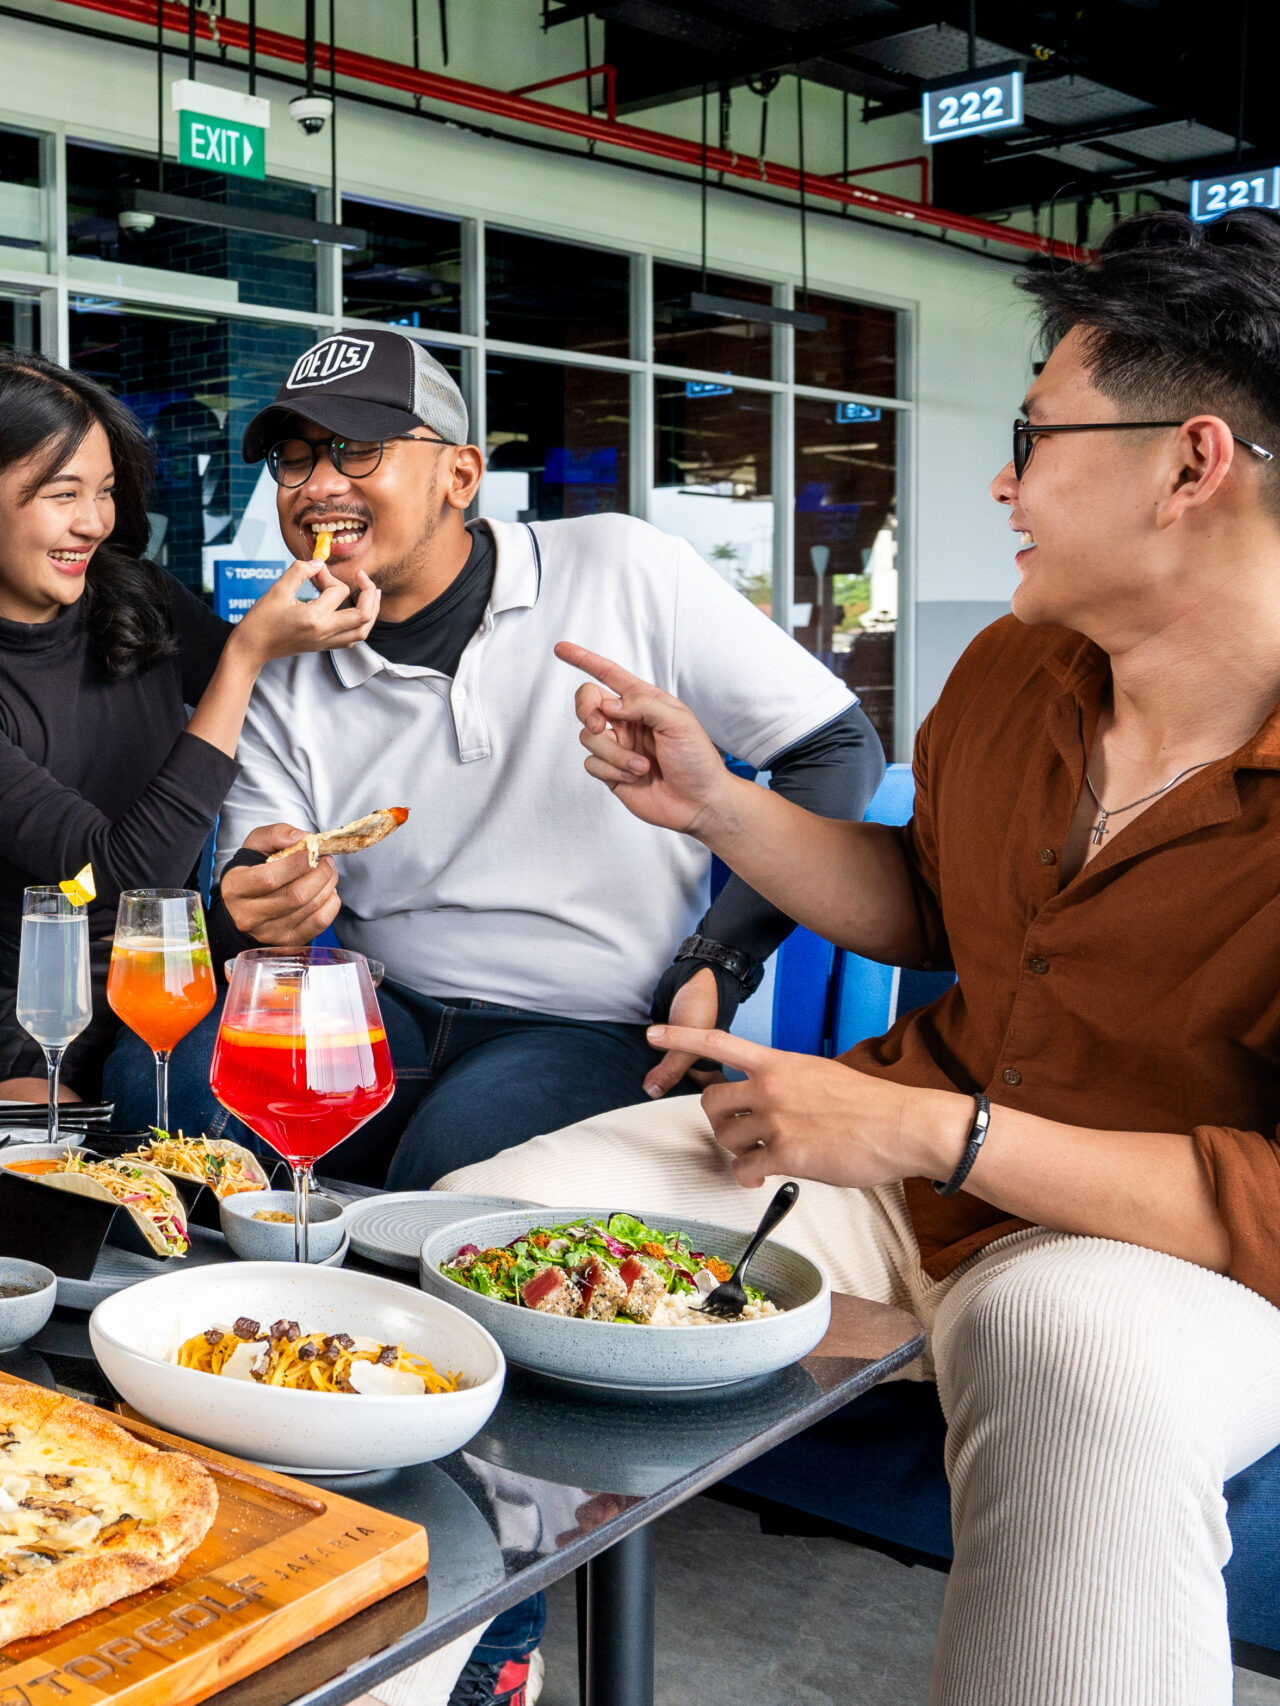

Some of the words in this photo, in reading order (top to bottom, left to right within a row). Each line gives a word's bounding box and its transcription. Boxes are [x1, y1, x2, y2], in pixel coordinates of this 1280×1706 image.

[937, 86, 1004, 130] 222
[191, 122, 240, 166] EXIT
[1206, 177, 1265, 212] 221
[234, 567, 284, 580] TOPGOLF
[274, 1526, 376, 1581] JAKARTA
[24, 1573, 269, 1697] TOPGOLF
